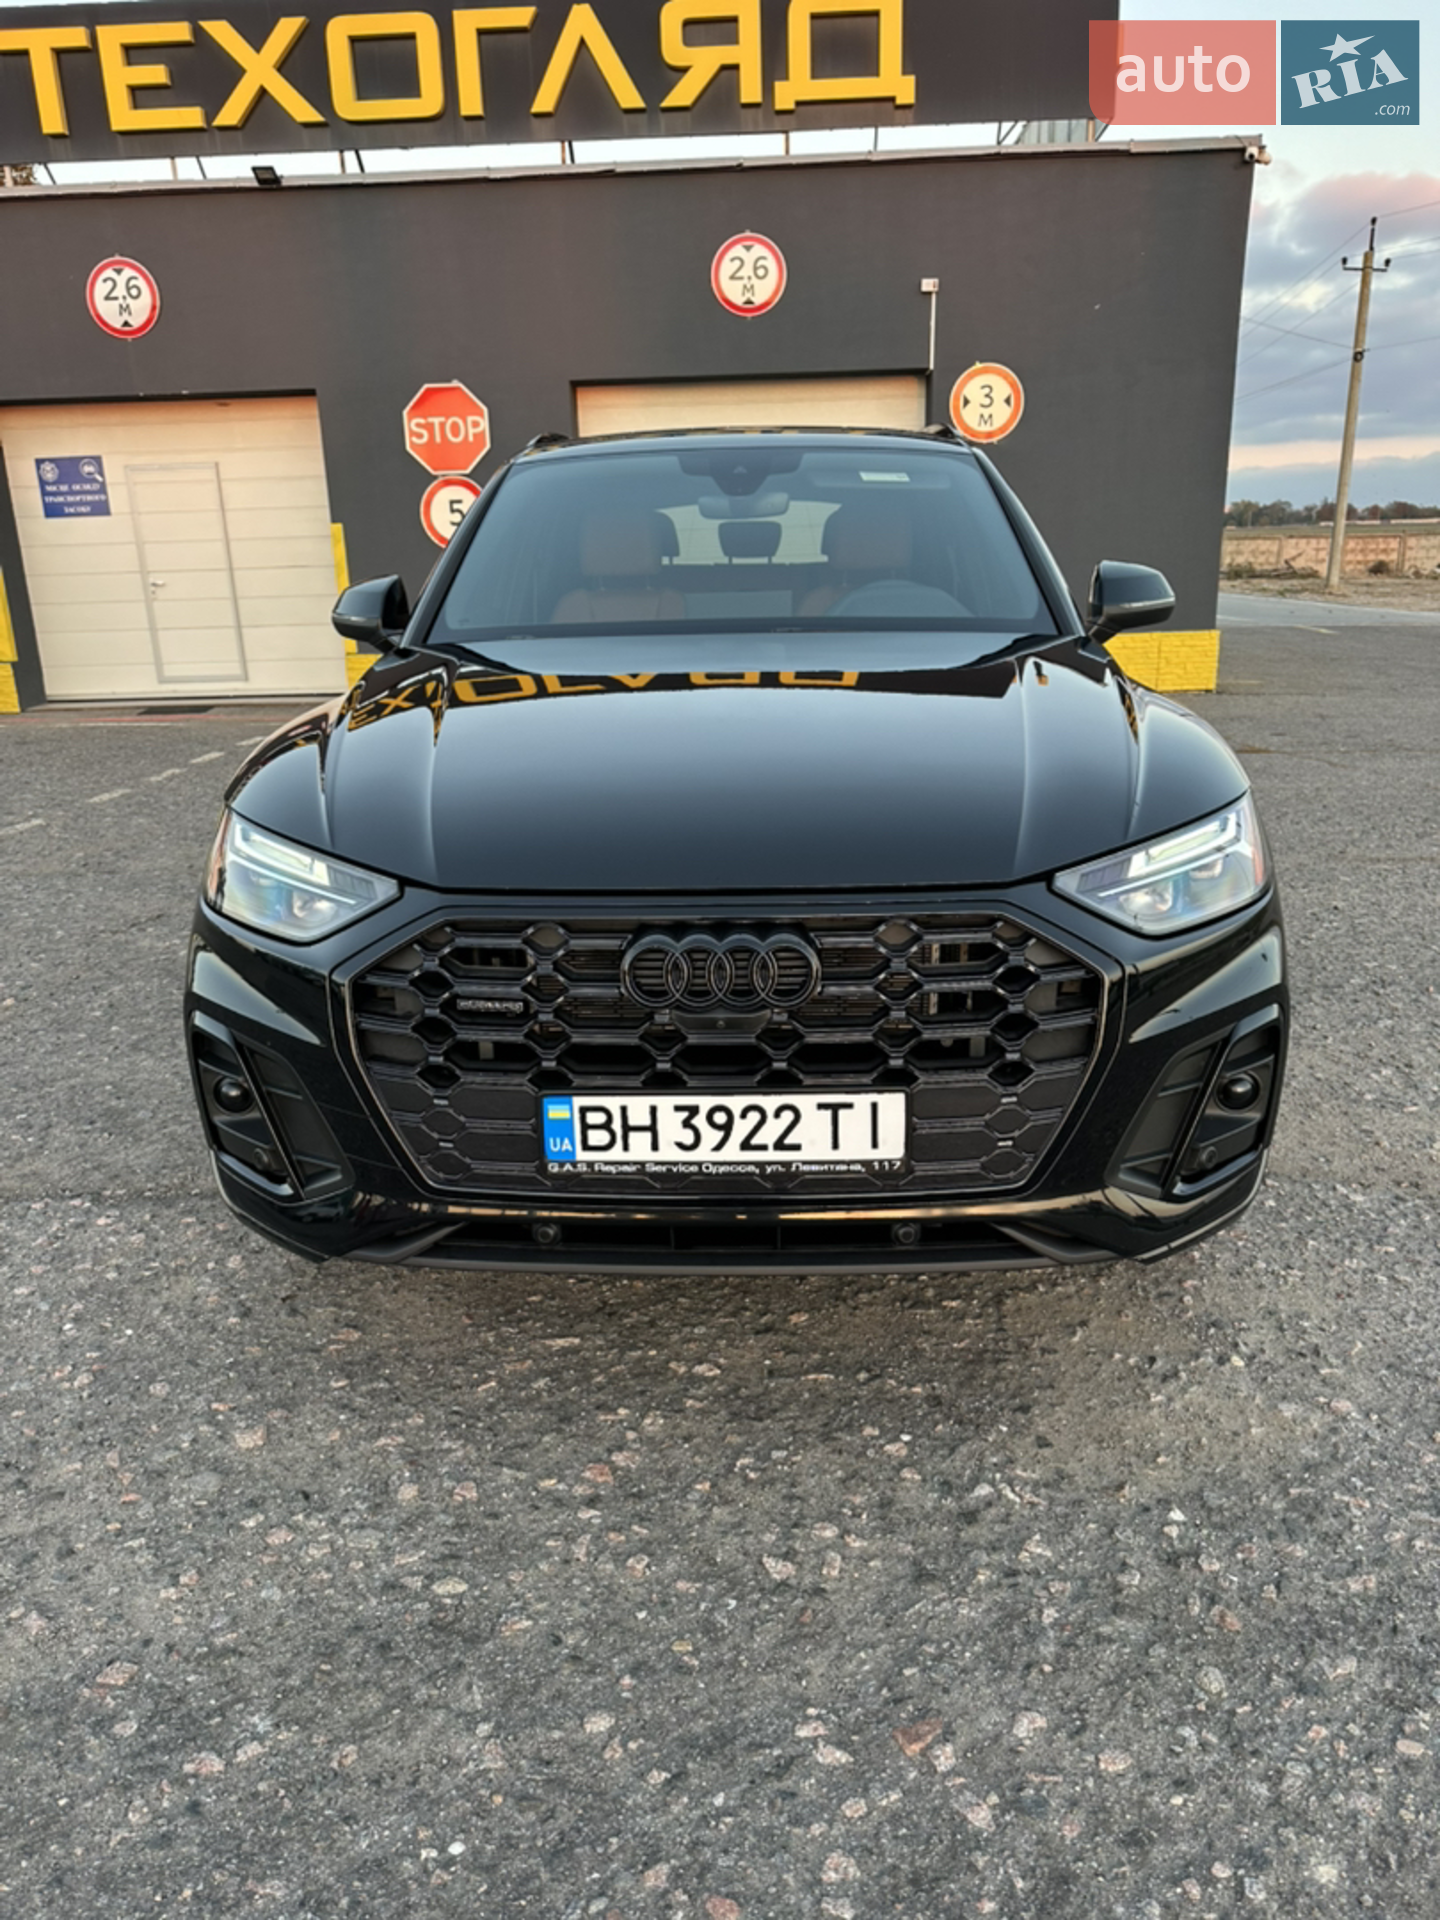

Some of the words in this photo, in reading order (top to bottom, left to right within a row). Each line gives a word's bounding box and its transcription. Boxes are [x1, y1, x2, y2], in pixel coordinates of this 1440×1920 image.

[0, 0, 915, 137] ТЕХОГЛЯД
[728, 255, 769, 282] 2,6
[102, 275, 142, 302] 2,6
[979, 384, 994, 409] 3
[409, 415, 485, 445] STOP
[579, 1104, 660, 1152] BH
[673, 1103, 803, 1152] 3922
[549, 1137, 573, 1152] UA
[547, 1162, 591, 1173] G.A.S.
[594, 1162, 641, 1174] Repair
[645, 1162, 699, 1173] Service
[701, 1162, 760, 1174] Одесса,
[872, 1160, 901, 1171] 117
